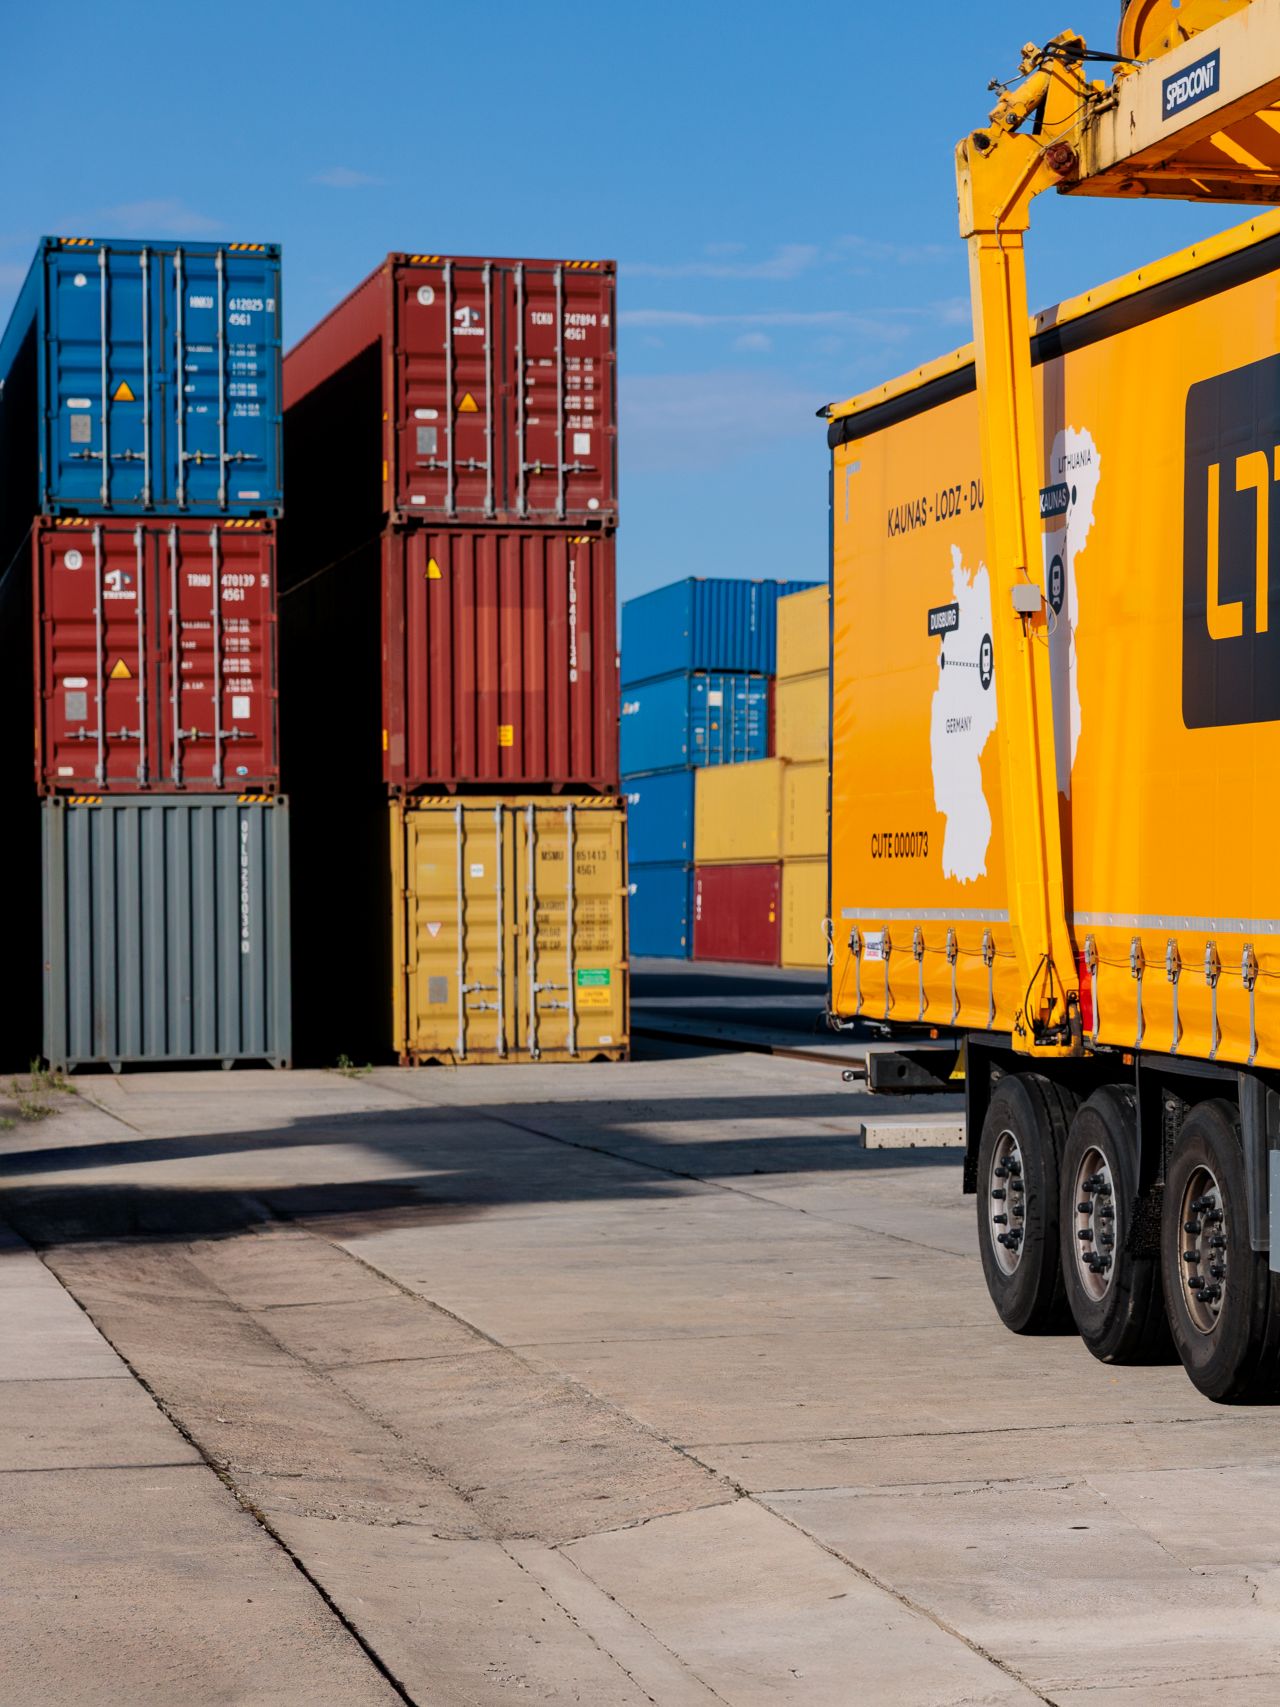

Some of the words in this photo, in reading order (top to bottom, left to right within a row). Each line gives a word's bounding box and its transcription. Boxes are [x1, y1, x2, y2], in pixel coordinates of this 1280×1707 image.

[1166, 60, 1216, 111] SPEDCONT
[228, 298, 264, 311] 612025
[564, 313, 597, 326] 747894
[564, 328, 586, 340] 45G1
[1058, 449, 1092, 473] LITHUANIA
[1040, 488, 1067, 513] KAUNAS
[887, 496, 927, 538] KAUNAS
[936, 484, 961, 522] LODZ
[221, 574, 255, 587] 470139
[930, 611, 956, 630] DUISBURG
[946, 716, 972, 734] GERMANY
[871, 833, 892, 858] CUTE
[894, 831, 929, 858] 0000173
